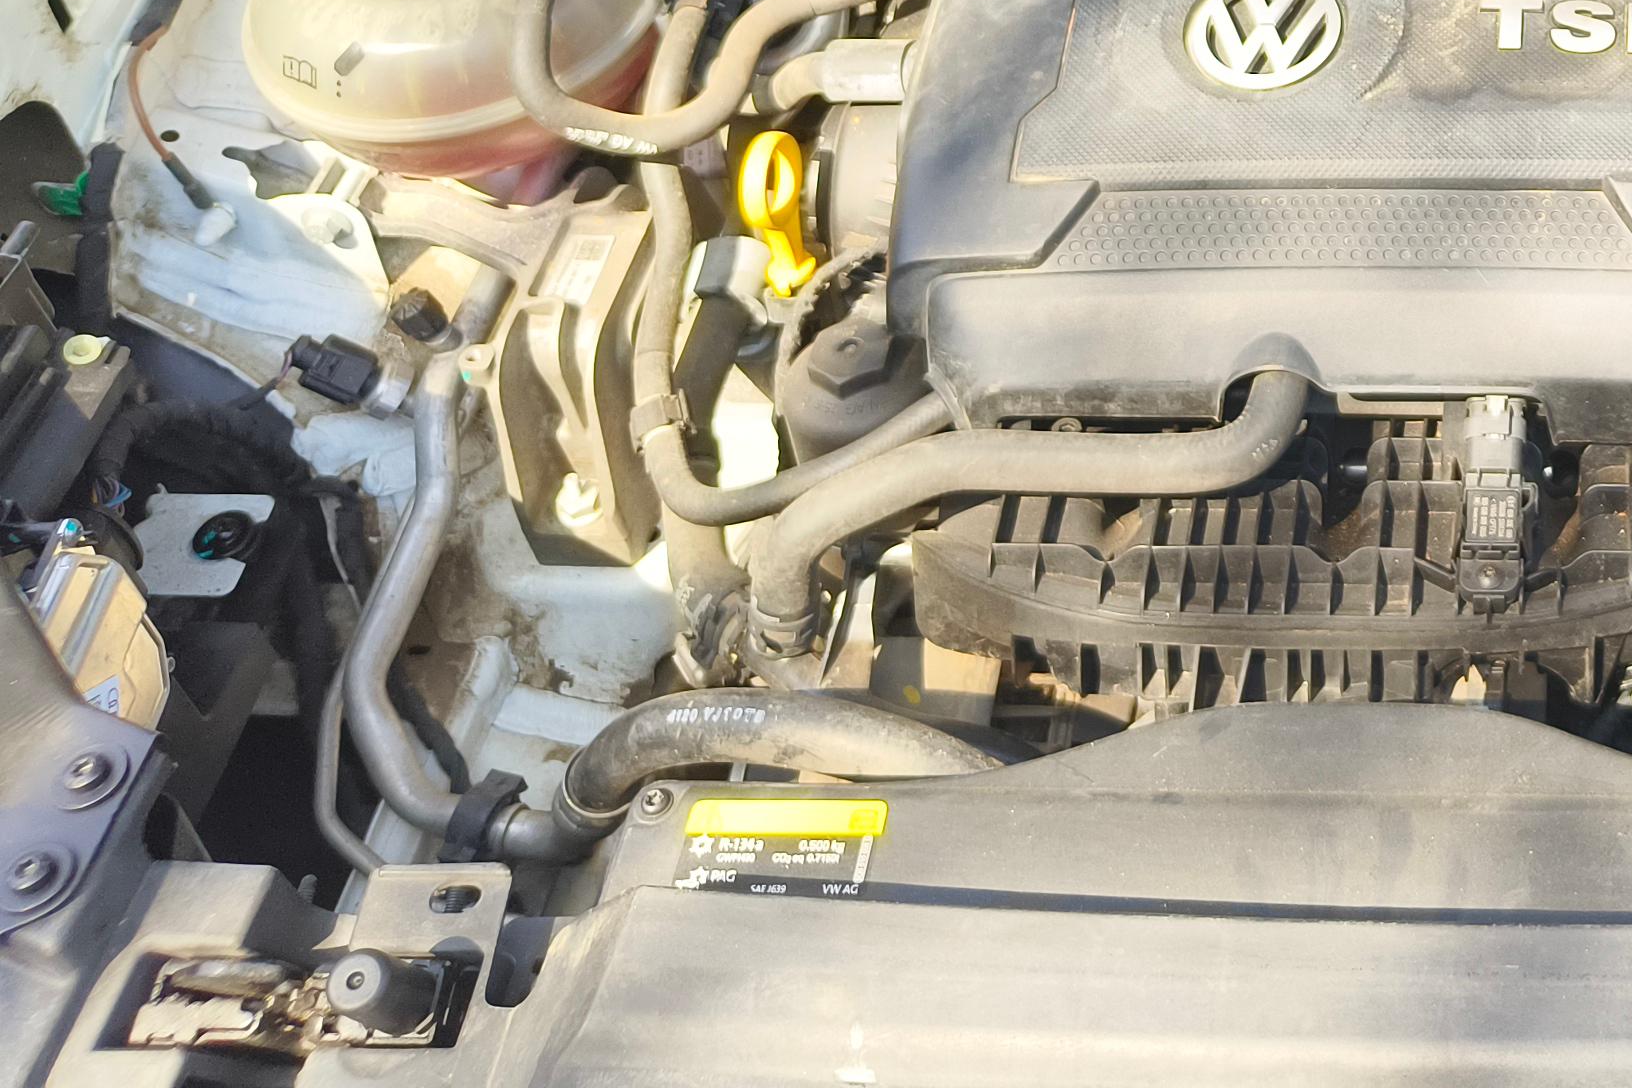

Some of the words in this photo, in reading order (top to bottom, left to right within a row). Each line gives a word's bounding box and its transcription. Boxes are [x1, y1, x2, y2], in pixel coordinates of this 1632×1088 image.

[718, 838, 765, 852] R-134a
[710, 869, 738, 883] PAG
[767, 884, 787, 894] J639
[822, 883, 842, 894] VW
[842, 884, 860, 895] AG
